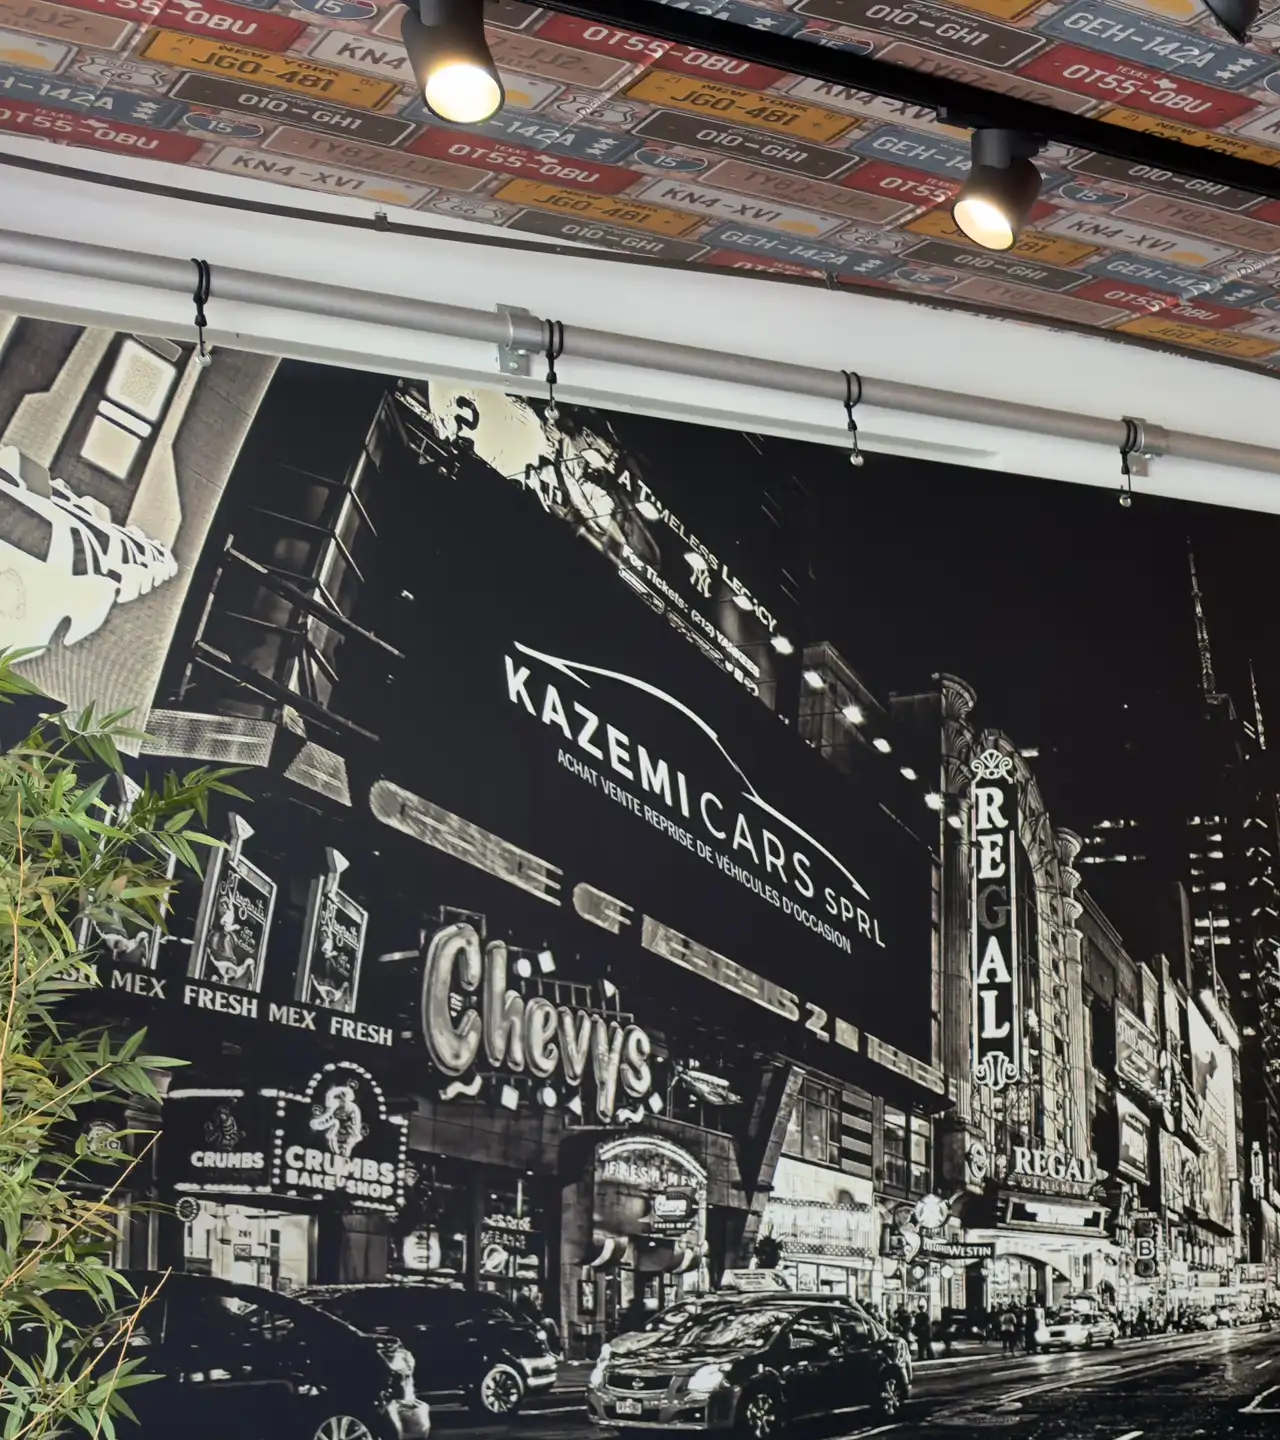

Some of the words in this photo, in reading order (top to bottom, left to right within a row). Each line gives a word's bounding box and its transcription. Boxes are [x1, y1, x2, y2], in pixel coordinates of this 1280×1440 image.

[1066, 12, 1213, 67] GEH-142A
[206, 120, 234, 134] 15
[232, 155, 362, 190] KN4-XV1
[652, 155, 680, 167] 15
[660, 188, 780, 221] KN4-XV1
[1074, 189, 1102, 201] 15
[721, 230, 847, 265] GEH-142A
[1065, 220, 1177, 251] KN4-XV1
[909, 272, 934, 282] 15
[504, 654, 690, 818] KAZEMI
[700, 791, 815, 899] CARS
[824, 887, 886, 949] SPRL
[557, 747, 599, 786] ACHAT
[600, 773, 643, 816] VENTE
[645, 796, 696, 850] REPRISE
[696, 839, 714, 863] DE
[714, 851, 781, 907] VÉHICULES
[781, 897, 852, 955] D'OCCASION
[110, 967, 167, 1000] MEX
[184, 984, 259, 1020] FRESH
[268, 1002, 317, 1033] MEX
[330, 1016, 394, 1048] FRESH
[421, 922, 652, 1123] Chevys
[190, 1150, 265, 1169] CRUMBS
[284, 1145, 396, 1186] CRUMBS
[1013, 1146, 1097, 1184] REGAL
[285, 1169, 337, 1191] BAKE
[345, 1178, 395, 1200] SHOP
